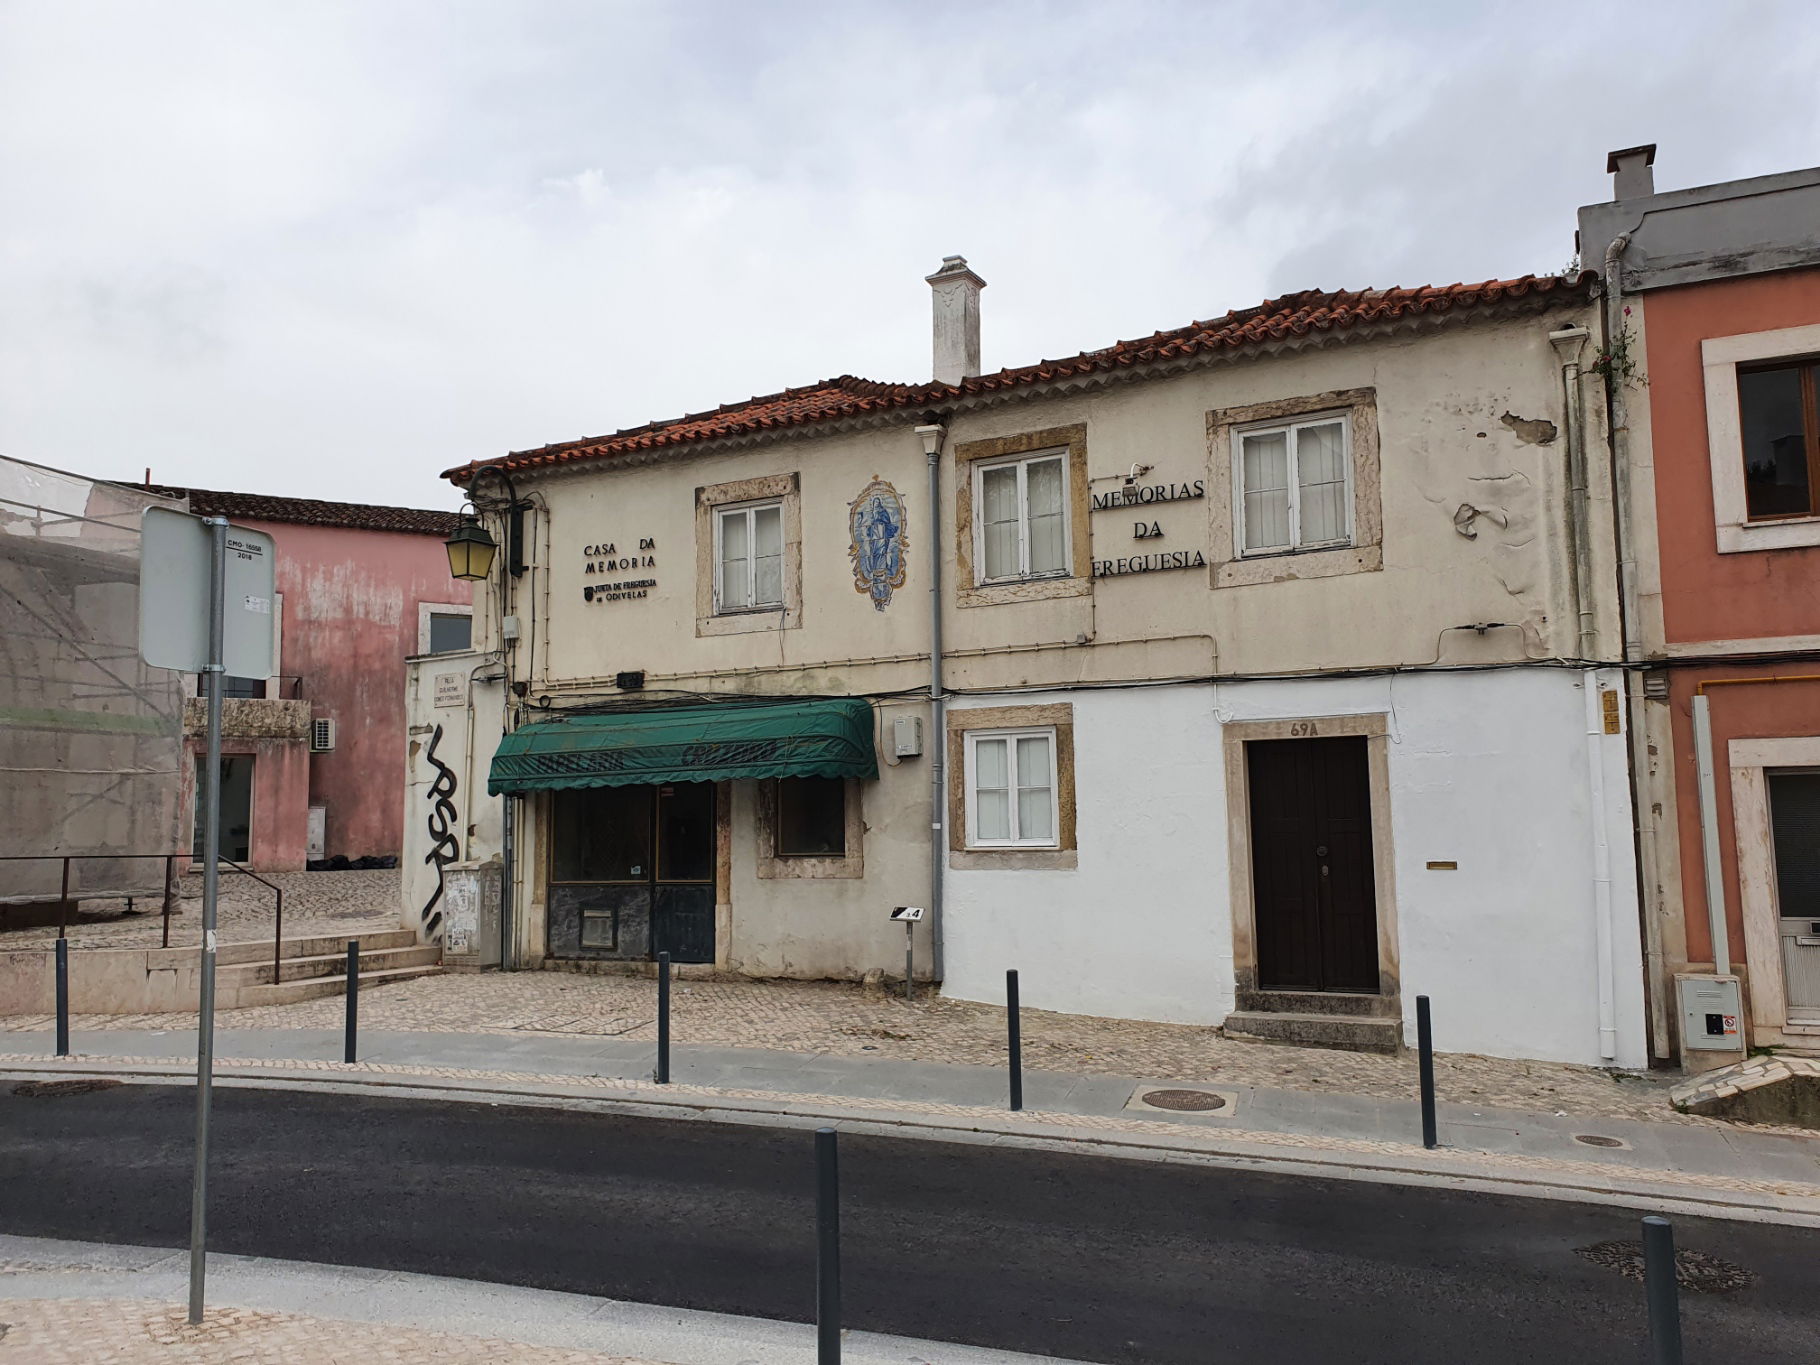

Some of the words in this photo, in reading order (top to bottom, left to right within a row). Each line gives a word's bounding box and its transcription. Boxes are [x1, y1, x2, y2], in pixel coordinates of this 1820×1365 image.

[1092, 480, 1205, 509] MEMORIAS
[1133, 521, 1164, 538] DA
[583, 543, 616, 556] CASA
[639, 537, 655, 549] DA
[585, 556, 655, 574] MEMORIA
[1091, 550, 1208, 578] FREGUESIA
[594, 584, 612, 592] JUNTA
[613, 582, 622, 590] DE
[623, 579, 656, 589] FREGUESIA
[606, 590, 647, 601] ODIVELAS
[1290, 722, 1319, 737] 69A
